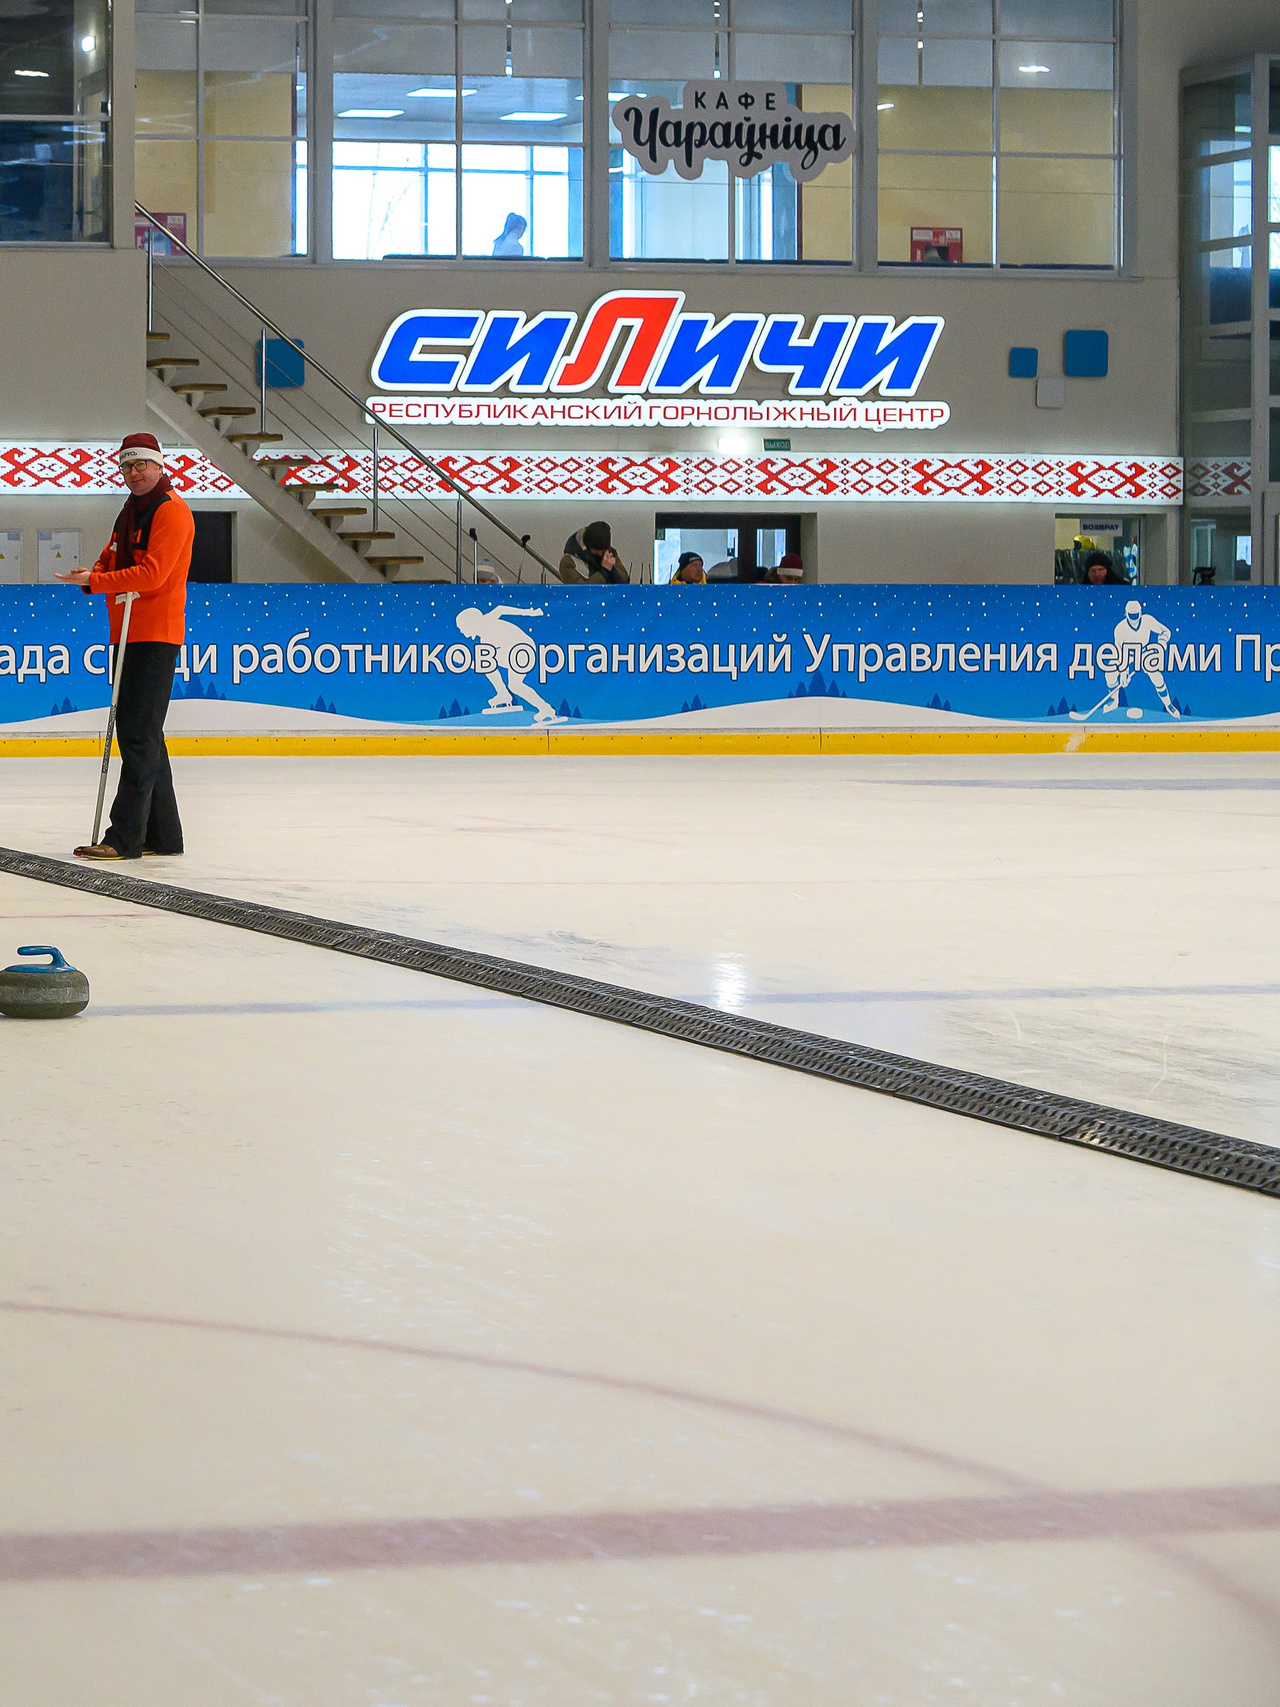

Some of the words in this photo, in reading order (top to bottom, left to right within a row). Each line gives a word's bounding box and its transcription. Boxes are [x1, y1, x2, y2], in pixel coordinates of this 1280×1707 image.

[693, 90, 777, 111] КАФЕ
[623, 106, 847, 171] Чараўніца
[371, 401, 643, 421] РЕСПУБЛИКАНСКИЙ
[648, 402, 858, 422] ГОРНОЛЫЖНЫЙ
[864, 407, 945, 426] ЦЕНТР
[231, 631, 499, 684] работников
[508, 632, 793, 684] организаций
[801, 633, 1059, 683] Управления
[1068, 641, 1222, 681] делами
